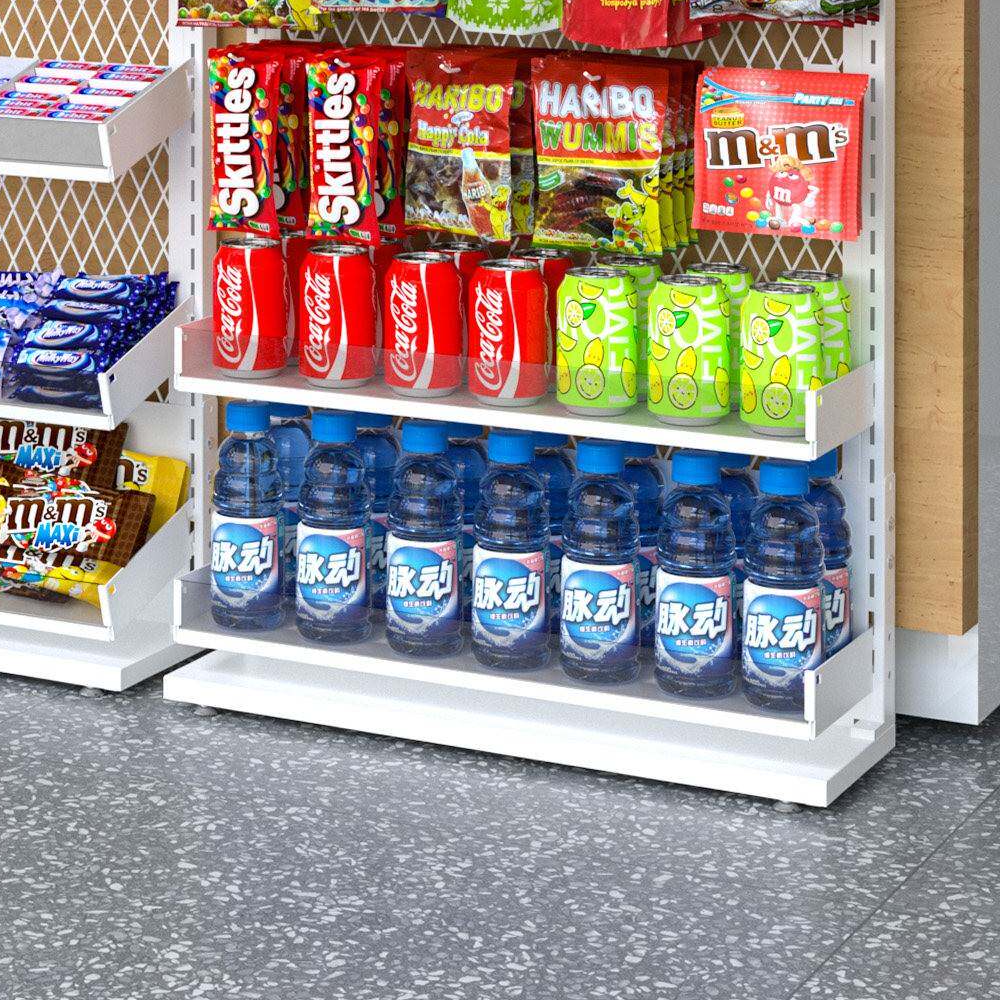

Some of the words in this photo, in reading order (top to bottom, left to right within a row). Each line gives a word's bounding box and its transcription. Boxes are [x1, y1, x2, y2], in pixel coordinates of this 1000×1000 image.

[414, 79, 503, 112] HARIBO
[538, 80, 657, 119] HARIBO
[215, 67, 260, 218] Skittles
[314, 72, 361, 225] Skittles
[417, 119, 457, 147] Happy
[459, 122, 490, 146] Cola
[539, 119, 658, 153] WUMMIS
[705, 123, 849, 167] m&m's
[774, 186, 792, 203] m
[7, 498, 109, 531] m&m's
[212, 535, 274, 576] 脉动
[299, 547, 362, 587] 脉动
[388, 558, 454, 600] 脉动
[474, 571, 541, 612] 脉动
[562, 583, 631, 625] 脉动
[657, 596, 728, 637] 脉动
[745, 608, 817, 651] 脉动
